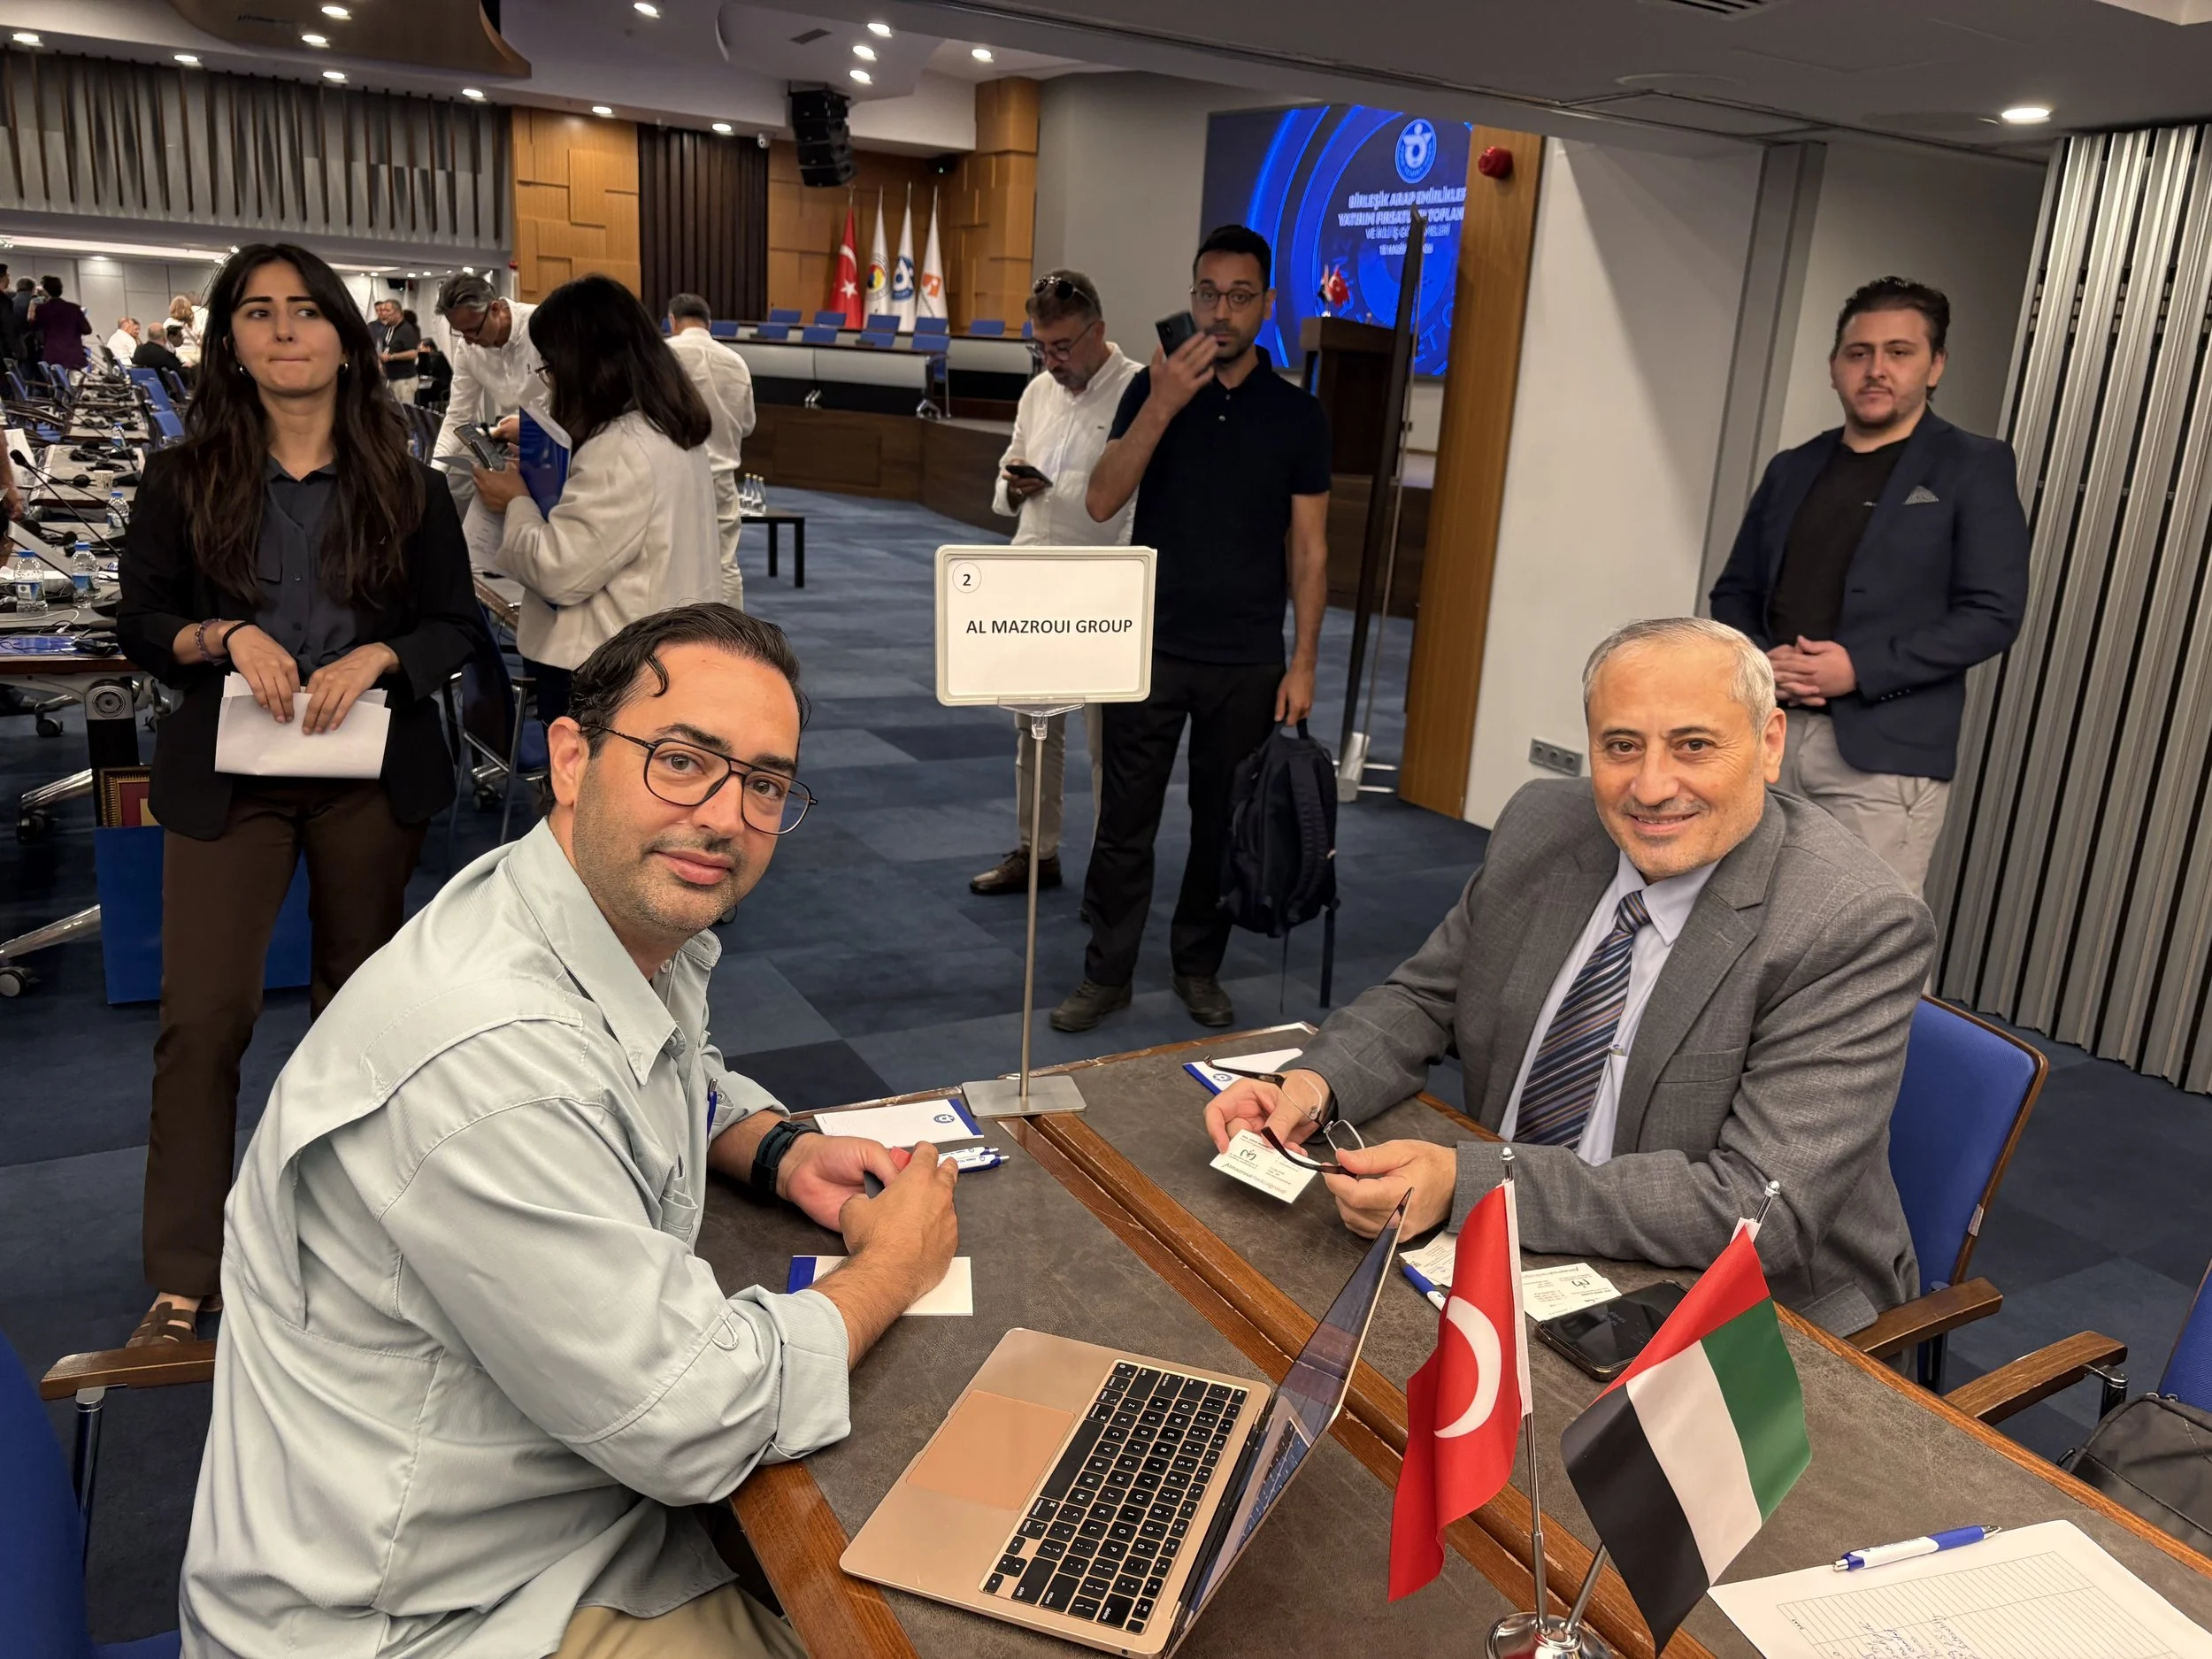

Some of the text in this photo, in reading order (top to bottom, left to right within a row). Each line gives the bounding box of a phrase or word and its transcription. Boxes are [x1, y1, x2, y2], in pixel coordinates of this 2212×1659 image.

[963, 574, 971, 586] 2
[966, 620, 1133, 634] AL MAZROUI GROUP
